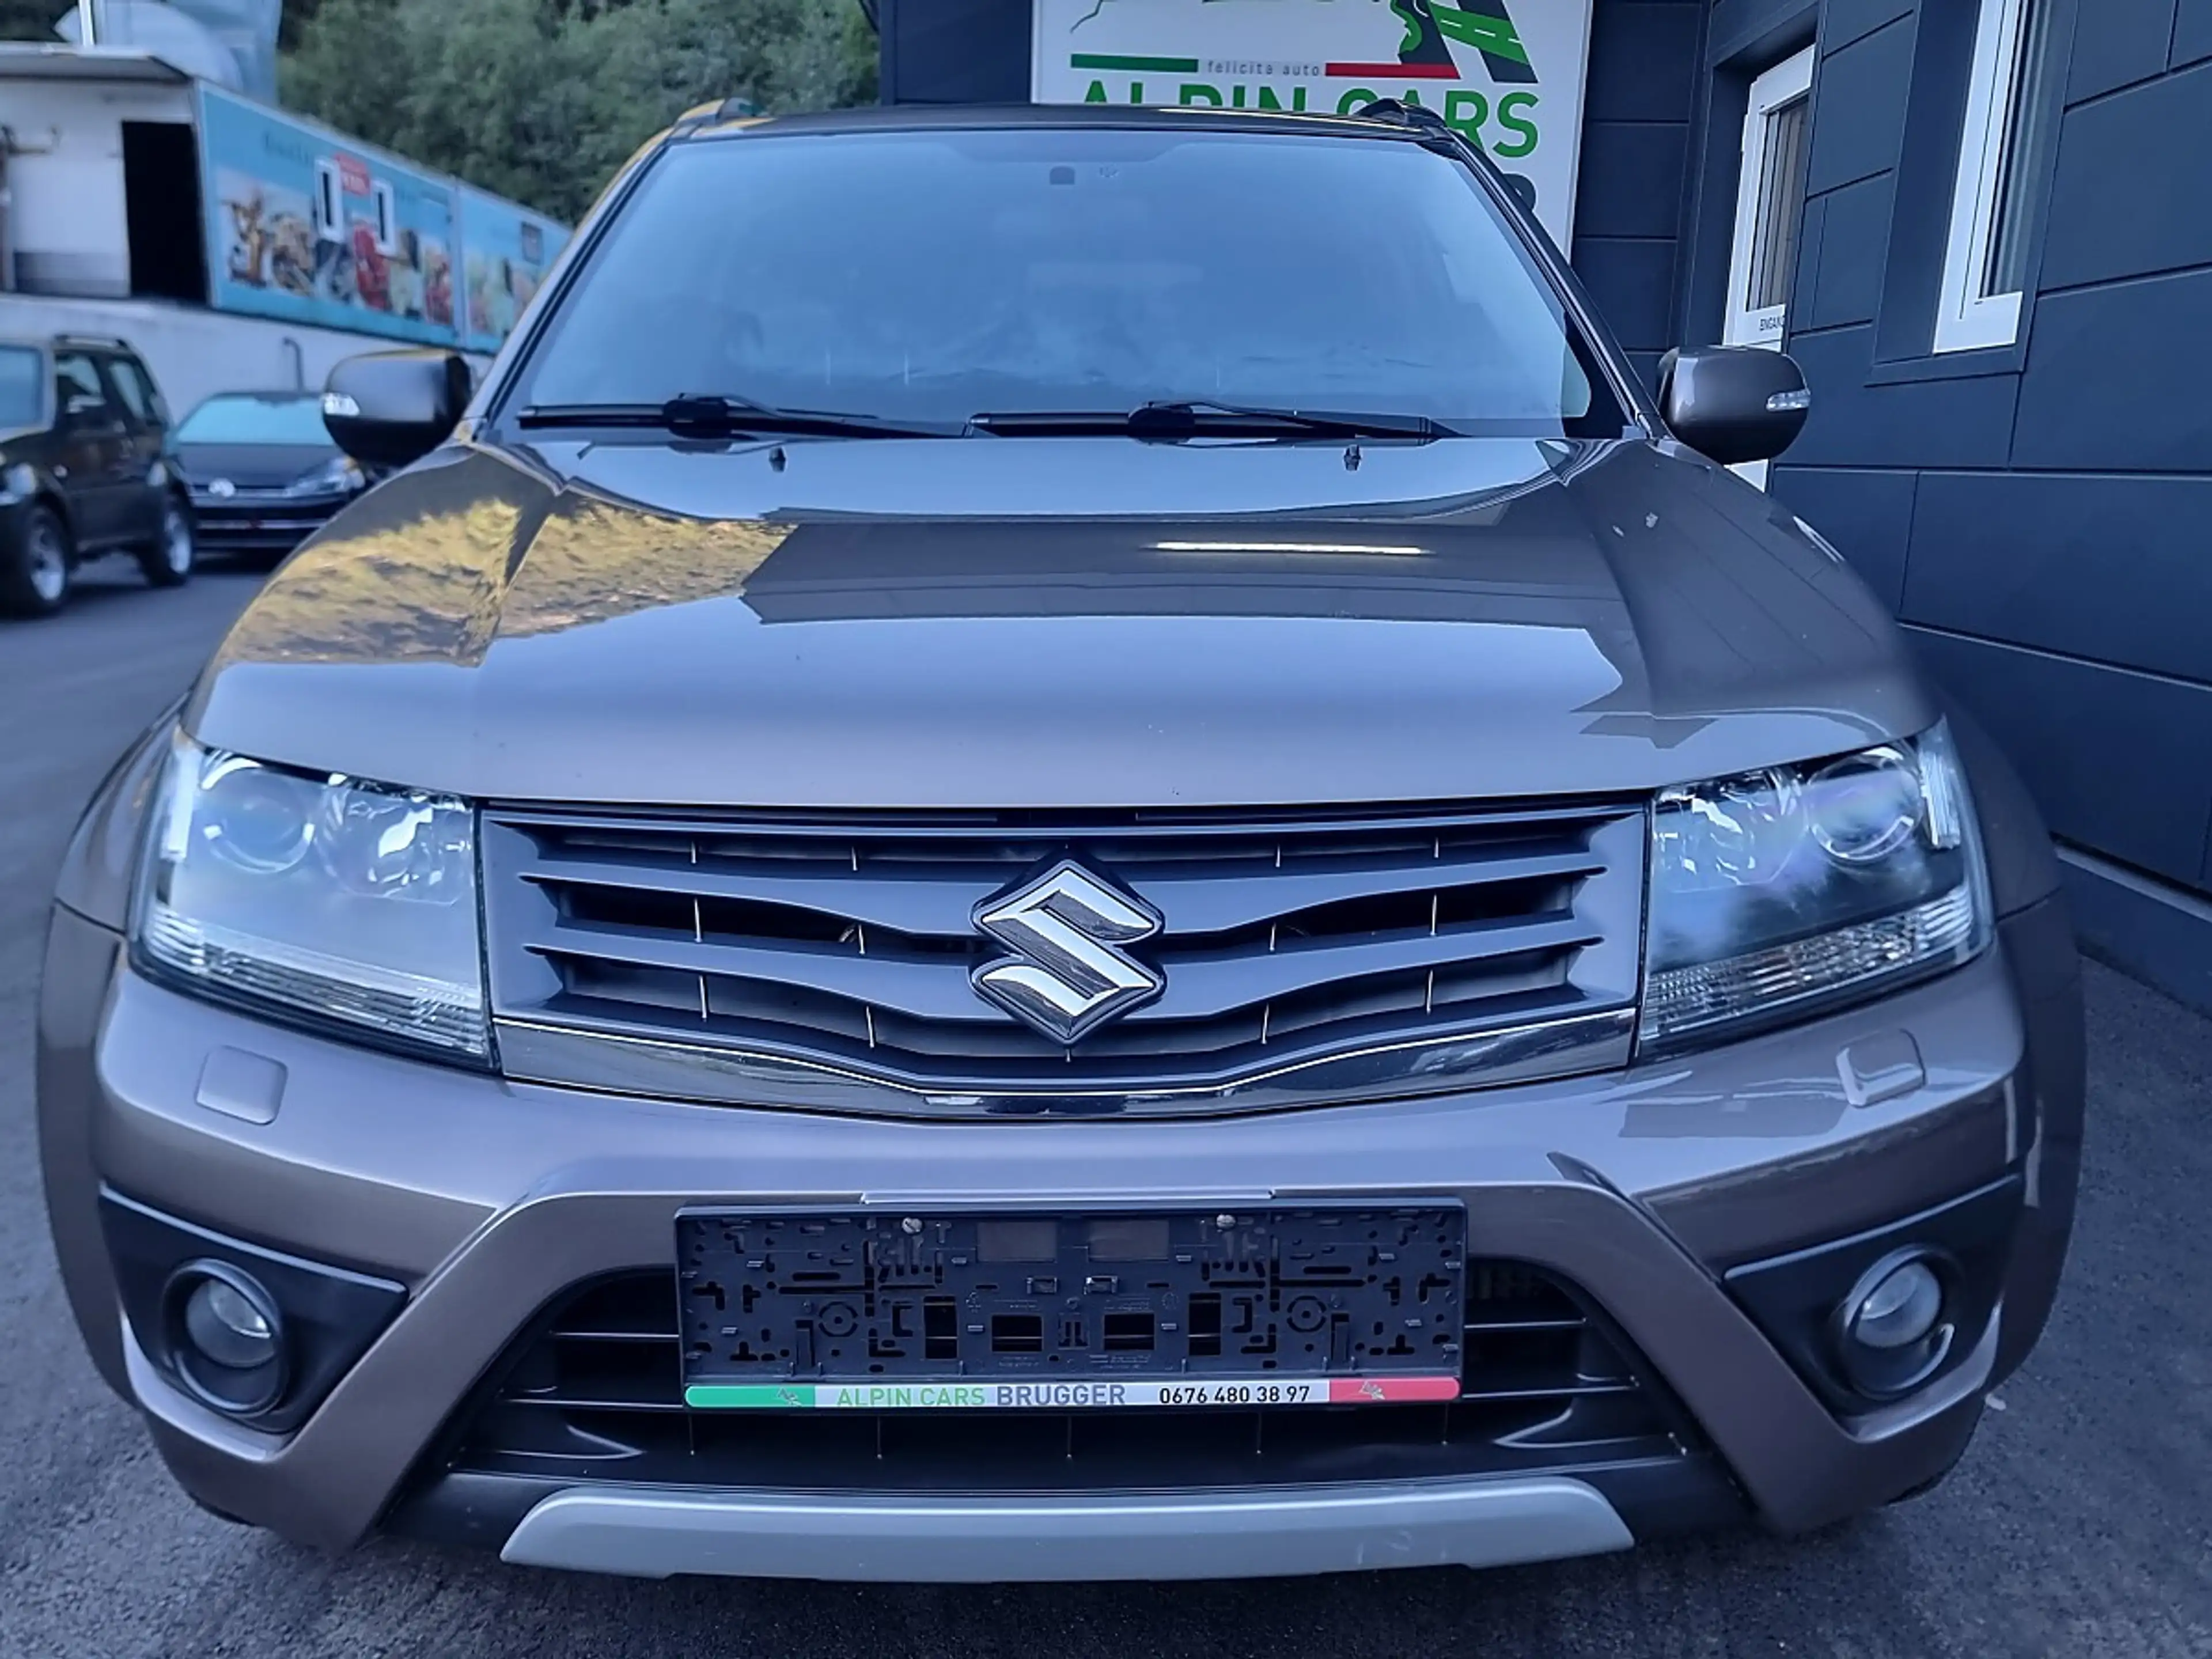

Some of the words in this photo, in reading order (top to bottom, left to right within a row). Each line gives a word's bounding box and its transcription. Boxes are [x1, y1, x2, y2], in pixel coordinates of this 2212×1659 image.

[1282, 63, 1321, 77] auto
[836, 1387, 911, 1407] ALPIN
[921, 1387, 986, 1407] CARS
[997, 1385, 1126, 1406] BRUGGER
[1159, 1387, 1207, 1404] 0676
[1214, 1386, 1249, 1403] 480
[1256, 1385, 1280, 1403] 38
[1286, 1385, 1310, 1402] 97
